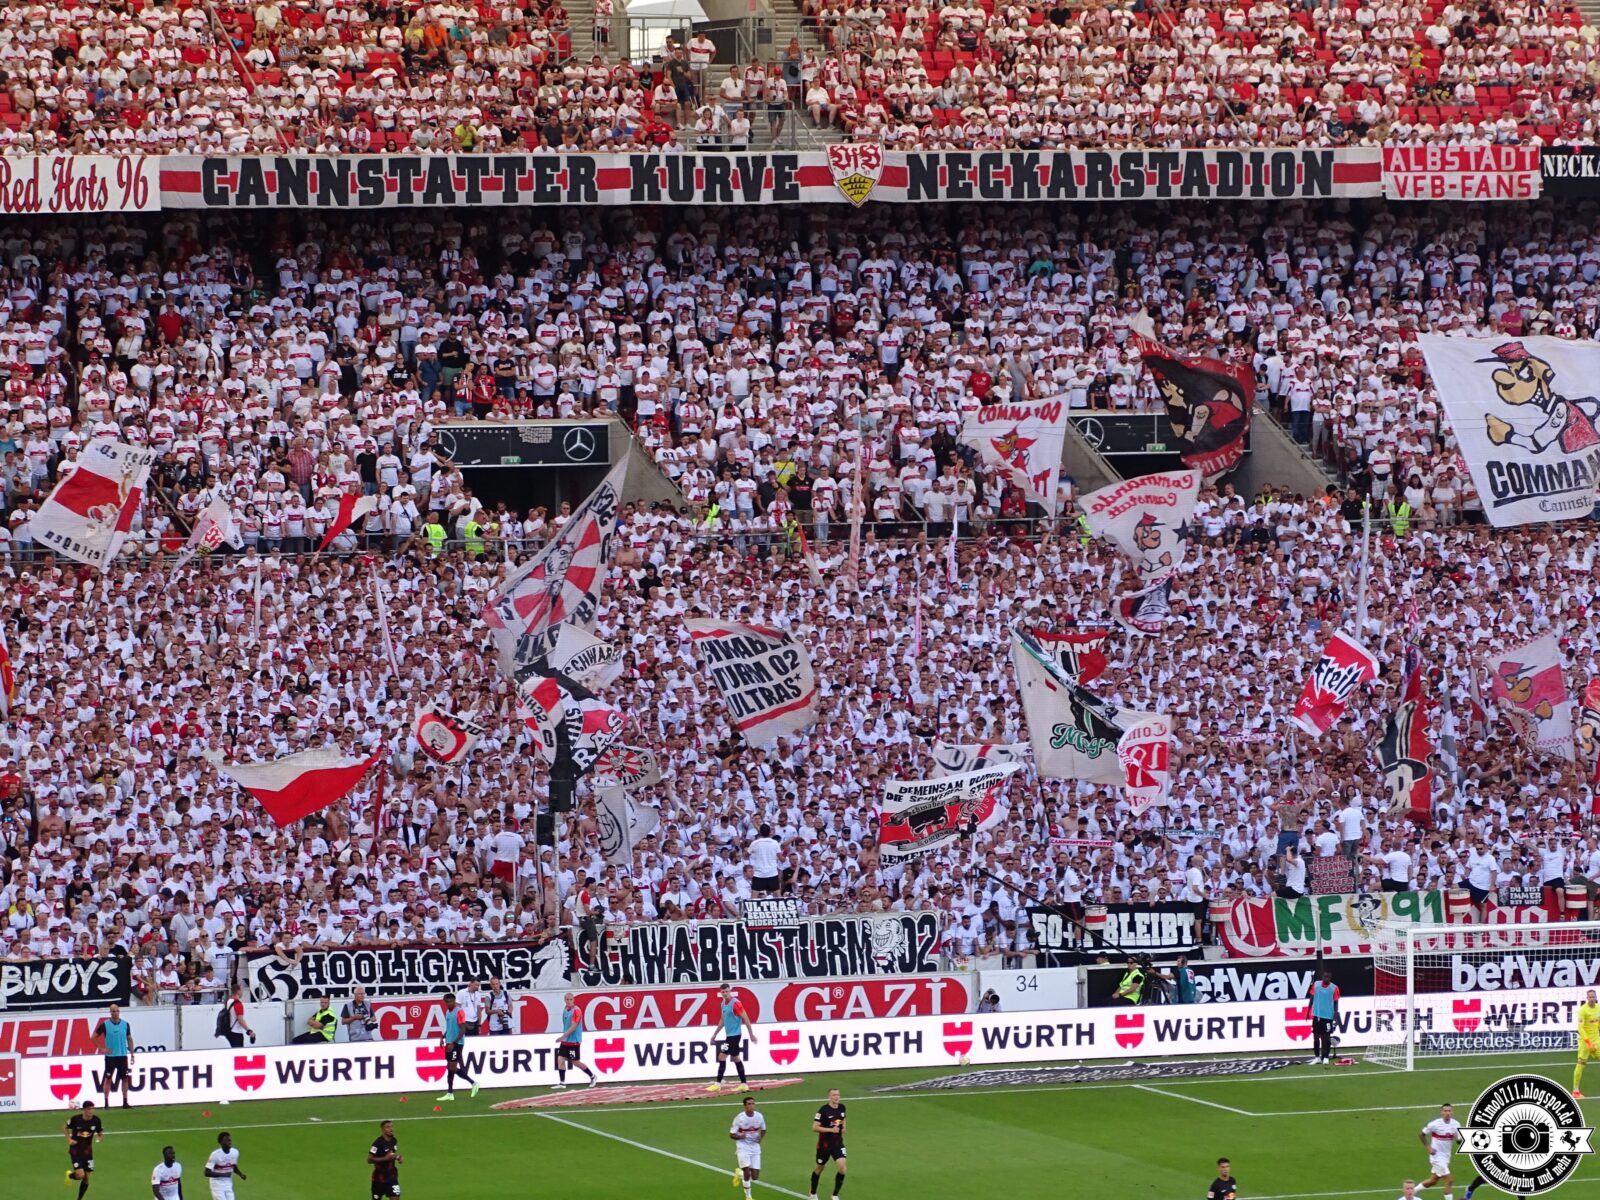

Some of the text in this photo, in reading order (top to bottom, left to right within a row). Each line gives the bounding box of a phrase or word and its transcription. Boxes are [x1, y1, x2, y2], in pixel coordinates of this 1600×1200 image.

[1390, 147, 1537, 171] ALBSTADT
[51, 155, 108, 213] Hots
[117, 156, 148, 211] 96
[202, 154, 799, 206] CANNSTATTER KURVE
[906, 150, 1334, 200] NECKARSTADION
[1394, 174, 1532, 198] VFB-FANS
[978, 400, 1062, 425] COMMADO
[768, 649, 800, 676] 02
[745, 901, 797, 912] ULTRAS
[1510, 892, 1541, 900] IMMER
[747, 911, 797, 919] BEDEUTET
[748, 918, 799, 926] WIDERSTAND
[1103, 912, 1195, 947] BLEIBT
[577, 912, 939, 987] SCHWABENSTURM 02
[0, 961, 119, 997] BWOYS
[300, 948, 532, 986] HOOLIGANS
[1016, 975, 1039, 992] 34
[584, 993, 738, 1030] GAZ
[1333, 1006, 1434, 1035] WÜRTH
[982, 1022, 1095, 1050] WÜRTH
[1154, 1014, 1266, 1042] WÜRTH
[1428, 1033, 1563, 1050] Mercedes-Benz
[634, 1038, 750, 1068] WÜRTH
[808, 1030, 923, 1058] WÜRTH
[276, 1055, 395, 1084] WÜRTH
[462, 1047, 574, 1076] WÜRTH
[92, 1064, 213, 1094] WÜRTH
